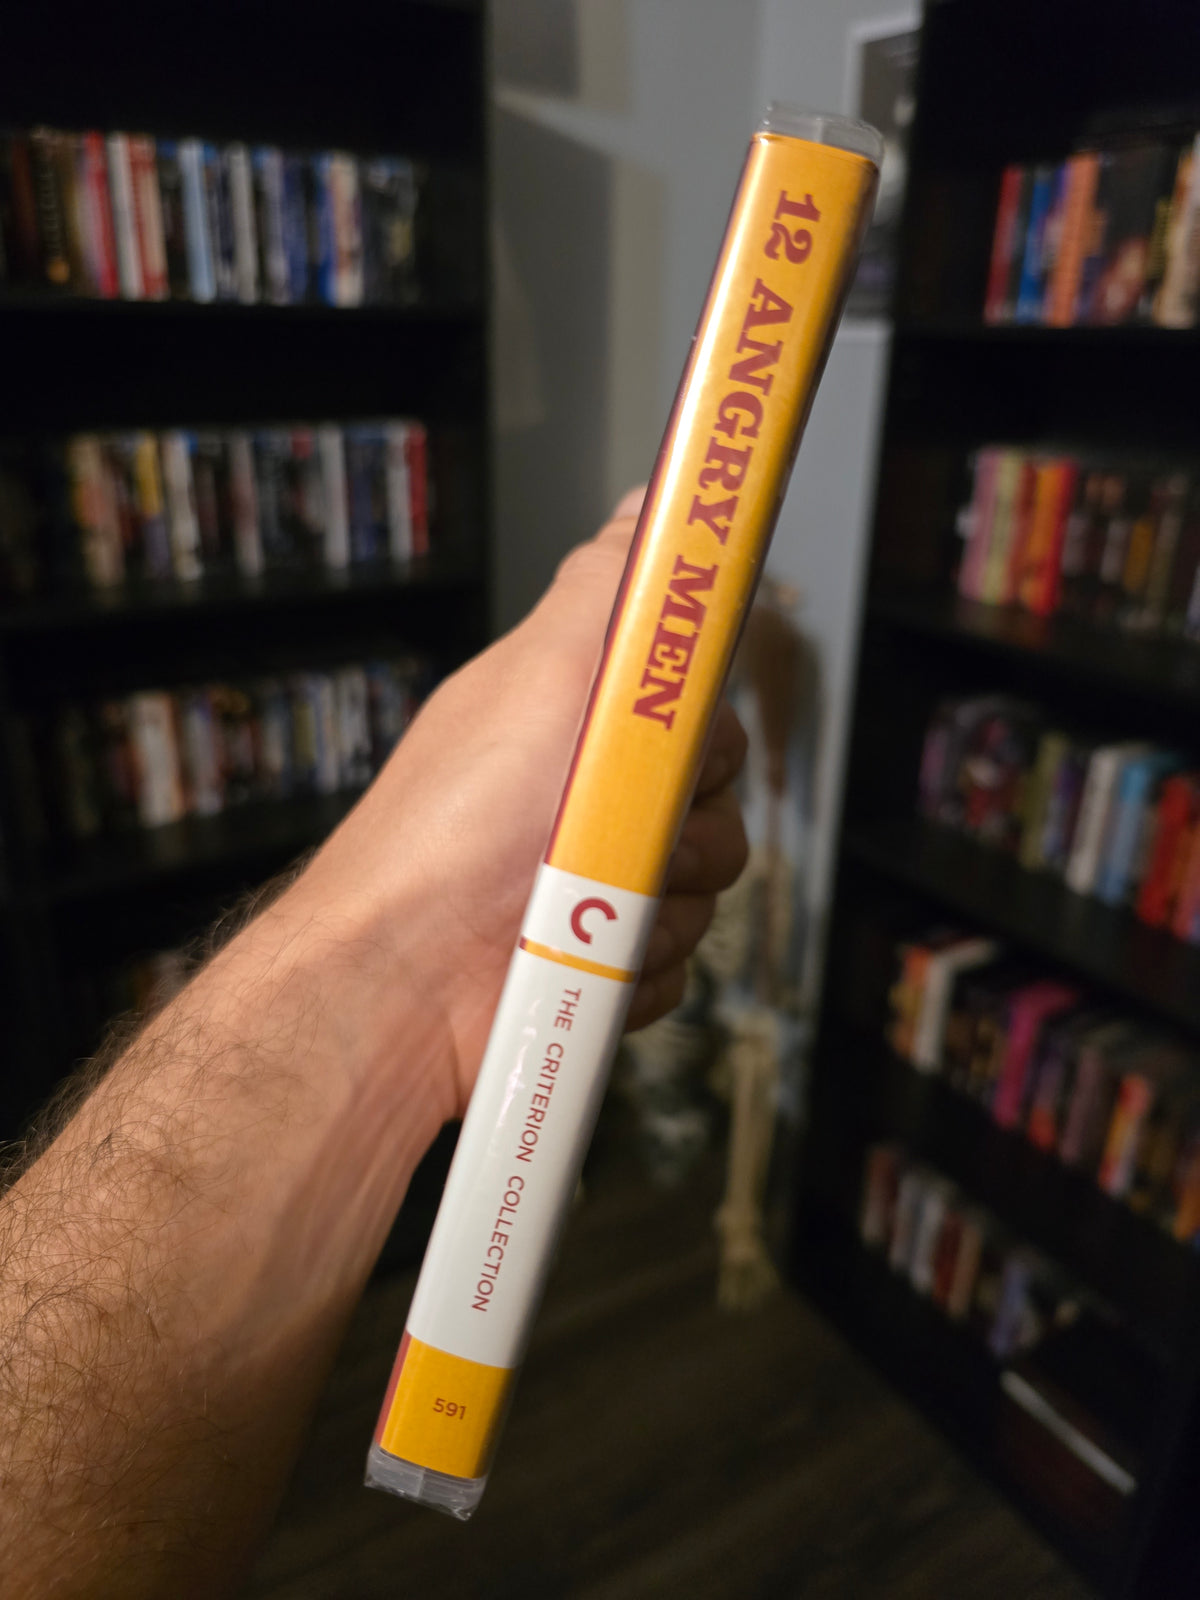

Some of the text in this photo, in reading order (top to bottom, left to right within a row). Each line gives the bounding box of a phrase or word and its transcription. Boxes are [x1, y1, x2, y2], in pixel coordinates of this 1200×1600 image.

[632, 190, 821, 731] 12 ANGRY MEN
[570, 896, 619, 945] C
[471, 987, 582, 1312] THE CRITERION COLLECTION
[432, 1397, 467, 1420] 591
